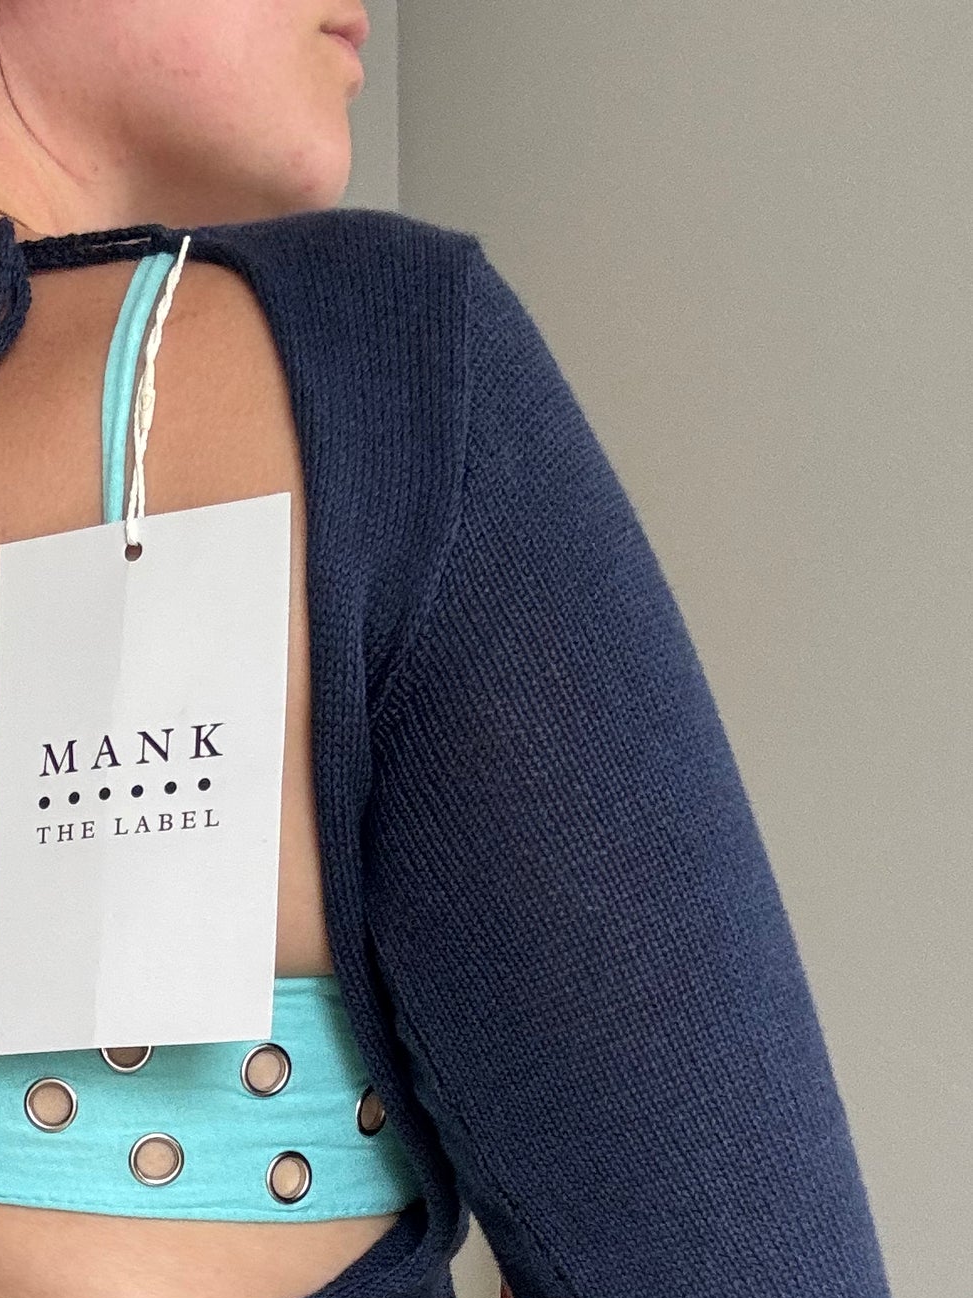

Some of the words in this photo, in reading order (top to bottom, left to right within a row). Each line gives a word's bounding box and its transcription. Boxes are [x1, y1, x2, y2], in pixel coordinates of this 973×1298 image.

[39, 722, 224, 777] MANK
[36, 820, 96, 845] THE
[114, 808, 220, 836] LABEL
